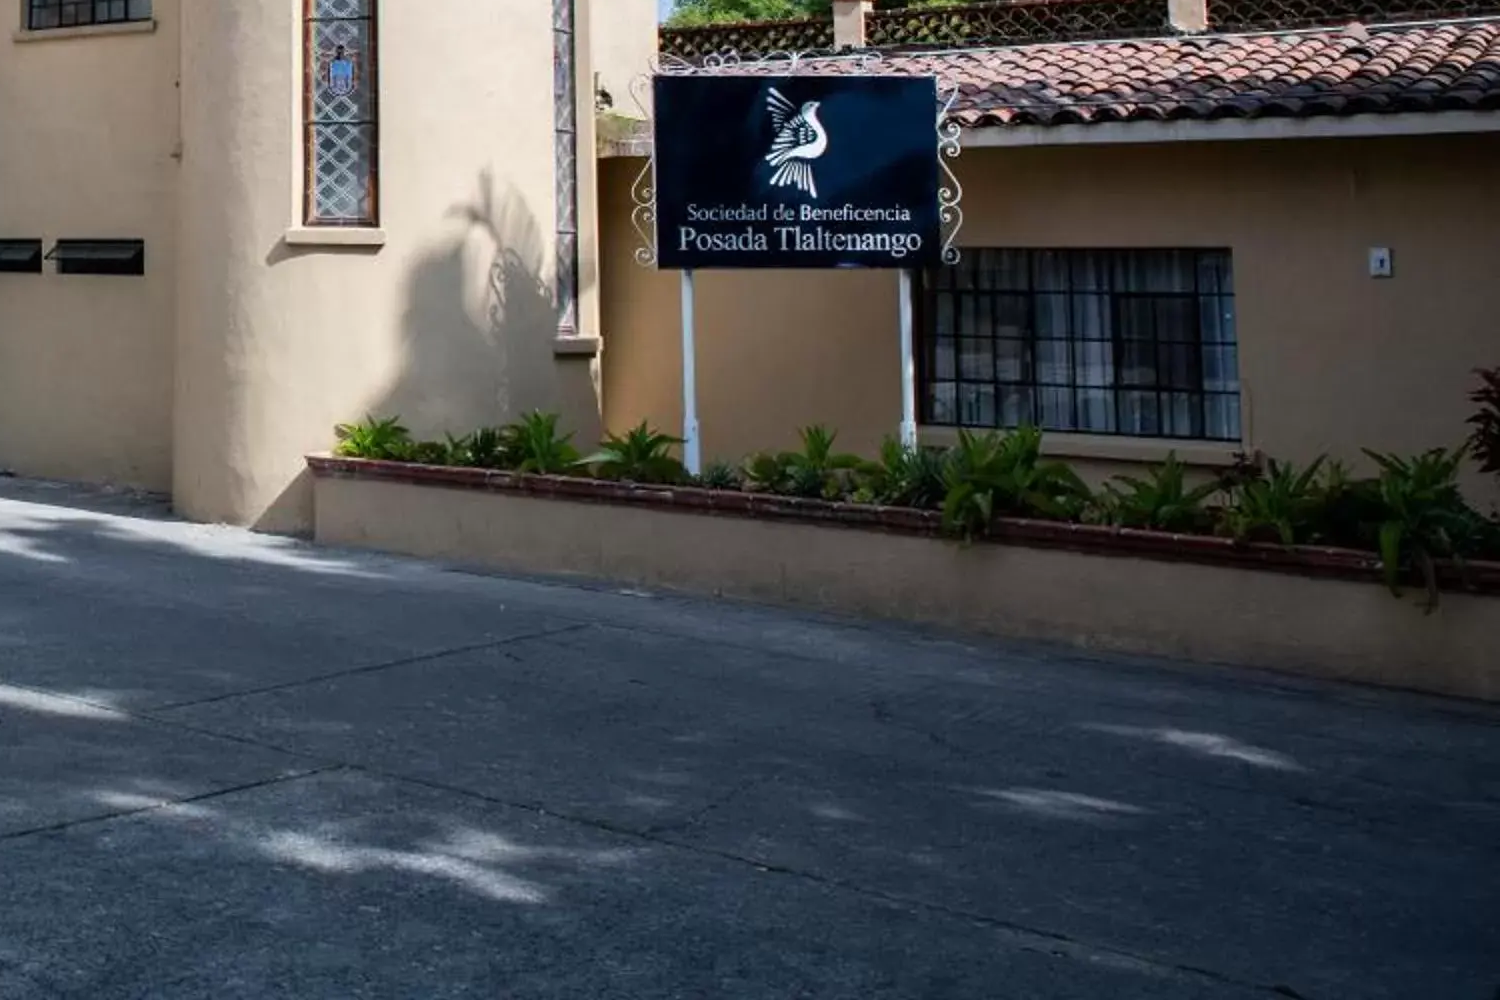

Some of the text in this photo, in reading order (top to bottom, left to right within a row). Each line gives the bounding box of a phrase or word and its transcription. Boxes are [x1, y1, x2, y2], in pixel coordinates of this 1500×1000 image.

[687, 203, 911, 221] Sociedad de Beneficencia
[679, 226, 922, 257] Posada Tlaltenango
